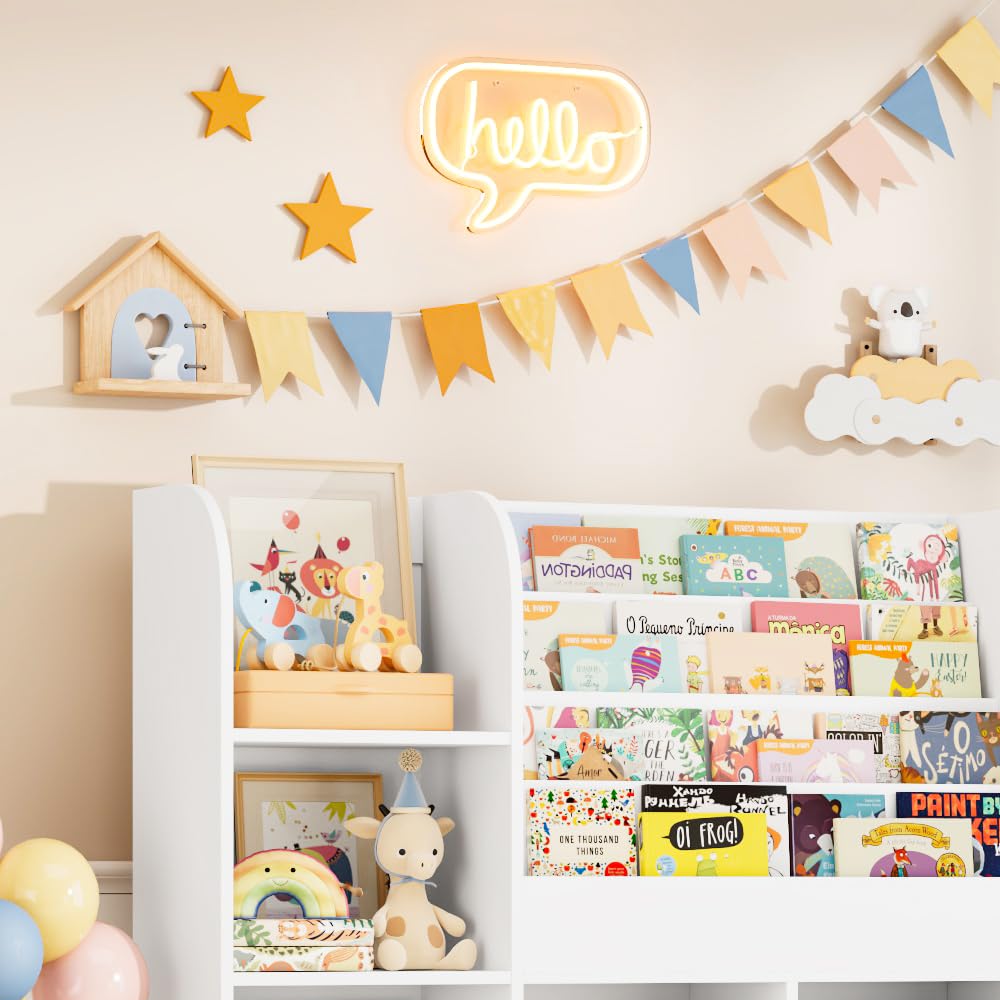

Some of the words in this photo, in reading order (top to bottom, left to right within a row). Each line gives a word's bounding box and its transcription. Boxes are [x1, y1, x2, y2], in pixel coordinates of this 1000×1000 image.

[462, 79, 641, 175] hello
[626, 615, 636, 634] O
[639, 615, 684, 635] Pequeno
[953, 720, 970, 755] O
[911, 793, 980, 817] PAINT
[559, 835, 575, 844] ONE
[578, 835, 619, 844] THOUSAND
[699, 818, 738, 848] FROG!
[576, 847, 604, 856] THINGS
